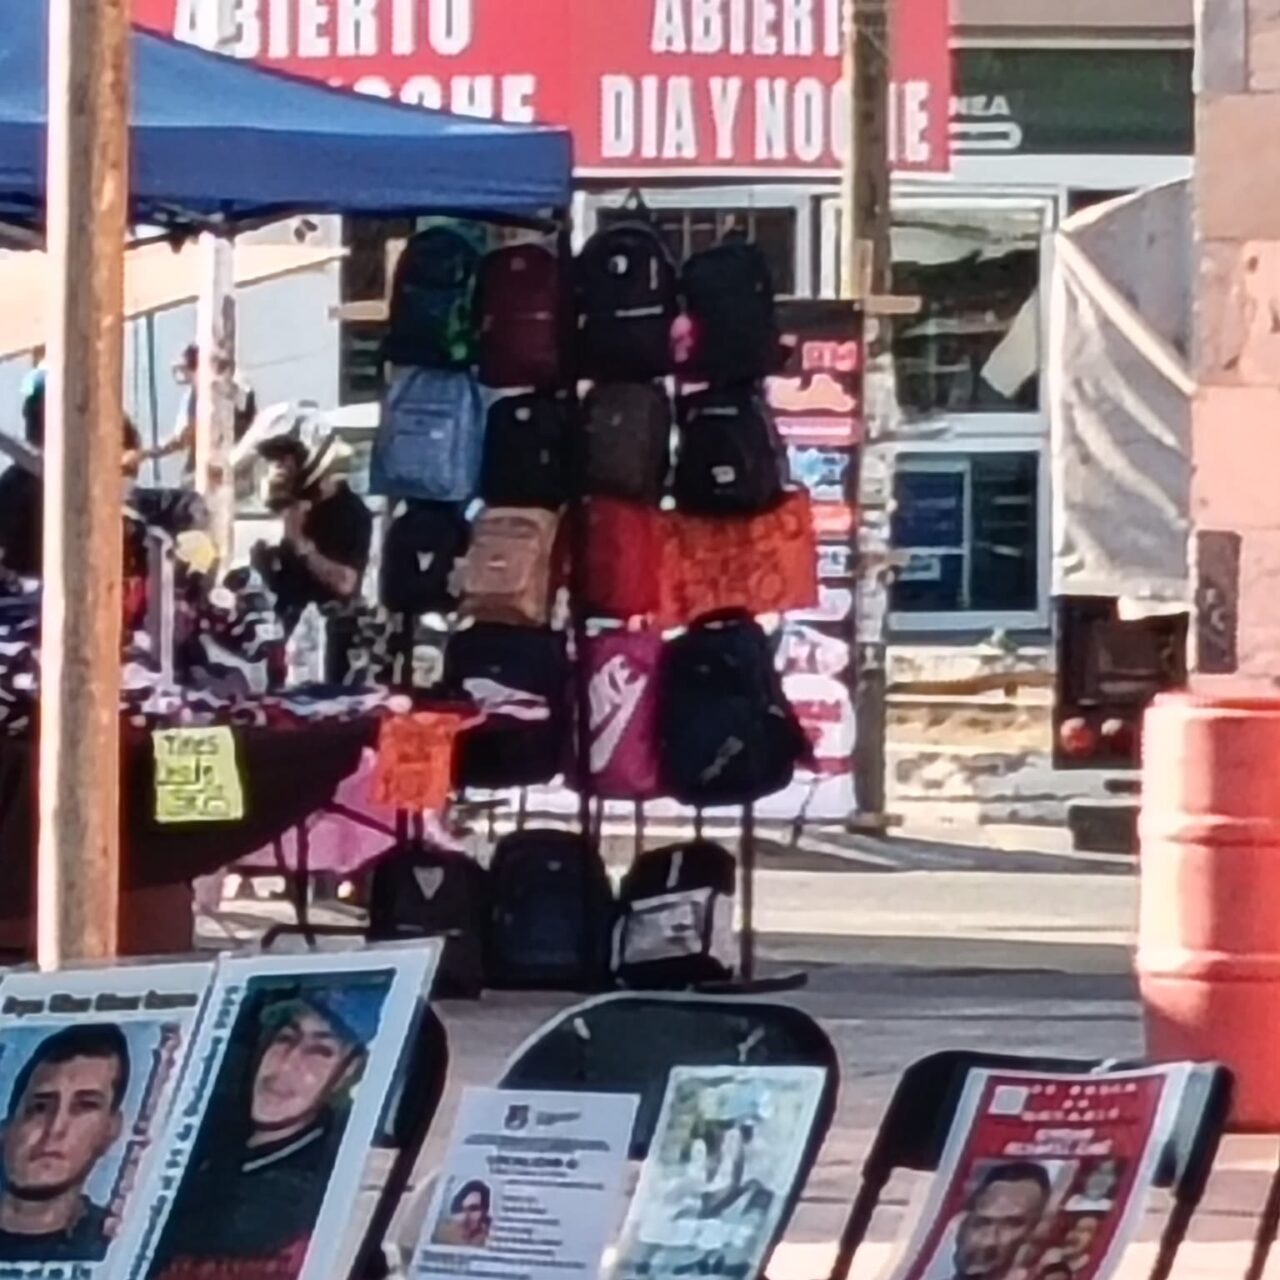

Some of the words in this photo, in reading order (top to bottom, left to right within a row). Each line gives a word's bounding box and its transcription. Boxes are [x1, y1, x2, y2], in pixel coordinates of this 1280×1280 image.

[651, 0, 842, 56] ABIERT
[601, 74, 697, 158] DIA
[708, 76, 742, 159] Y
